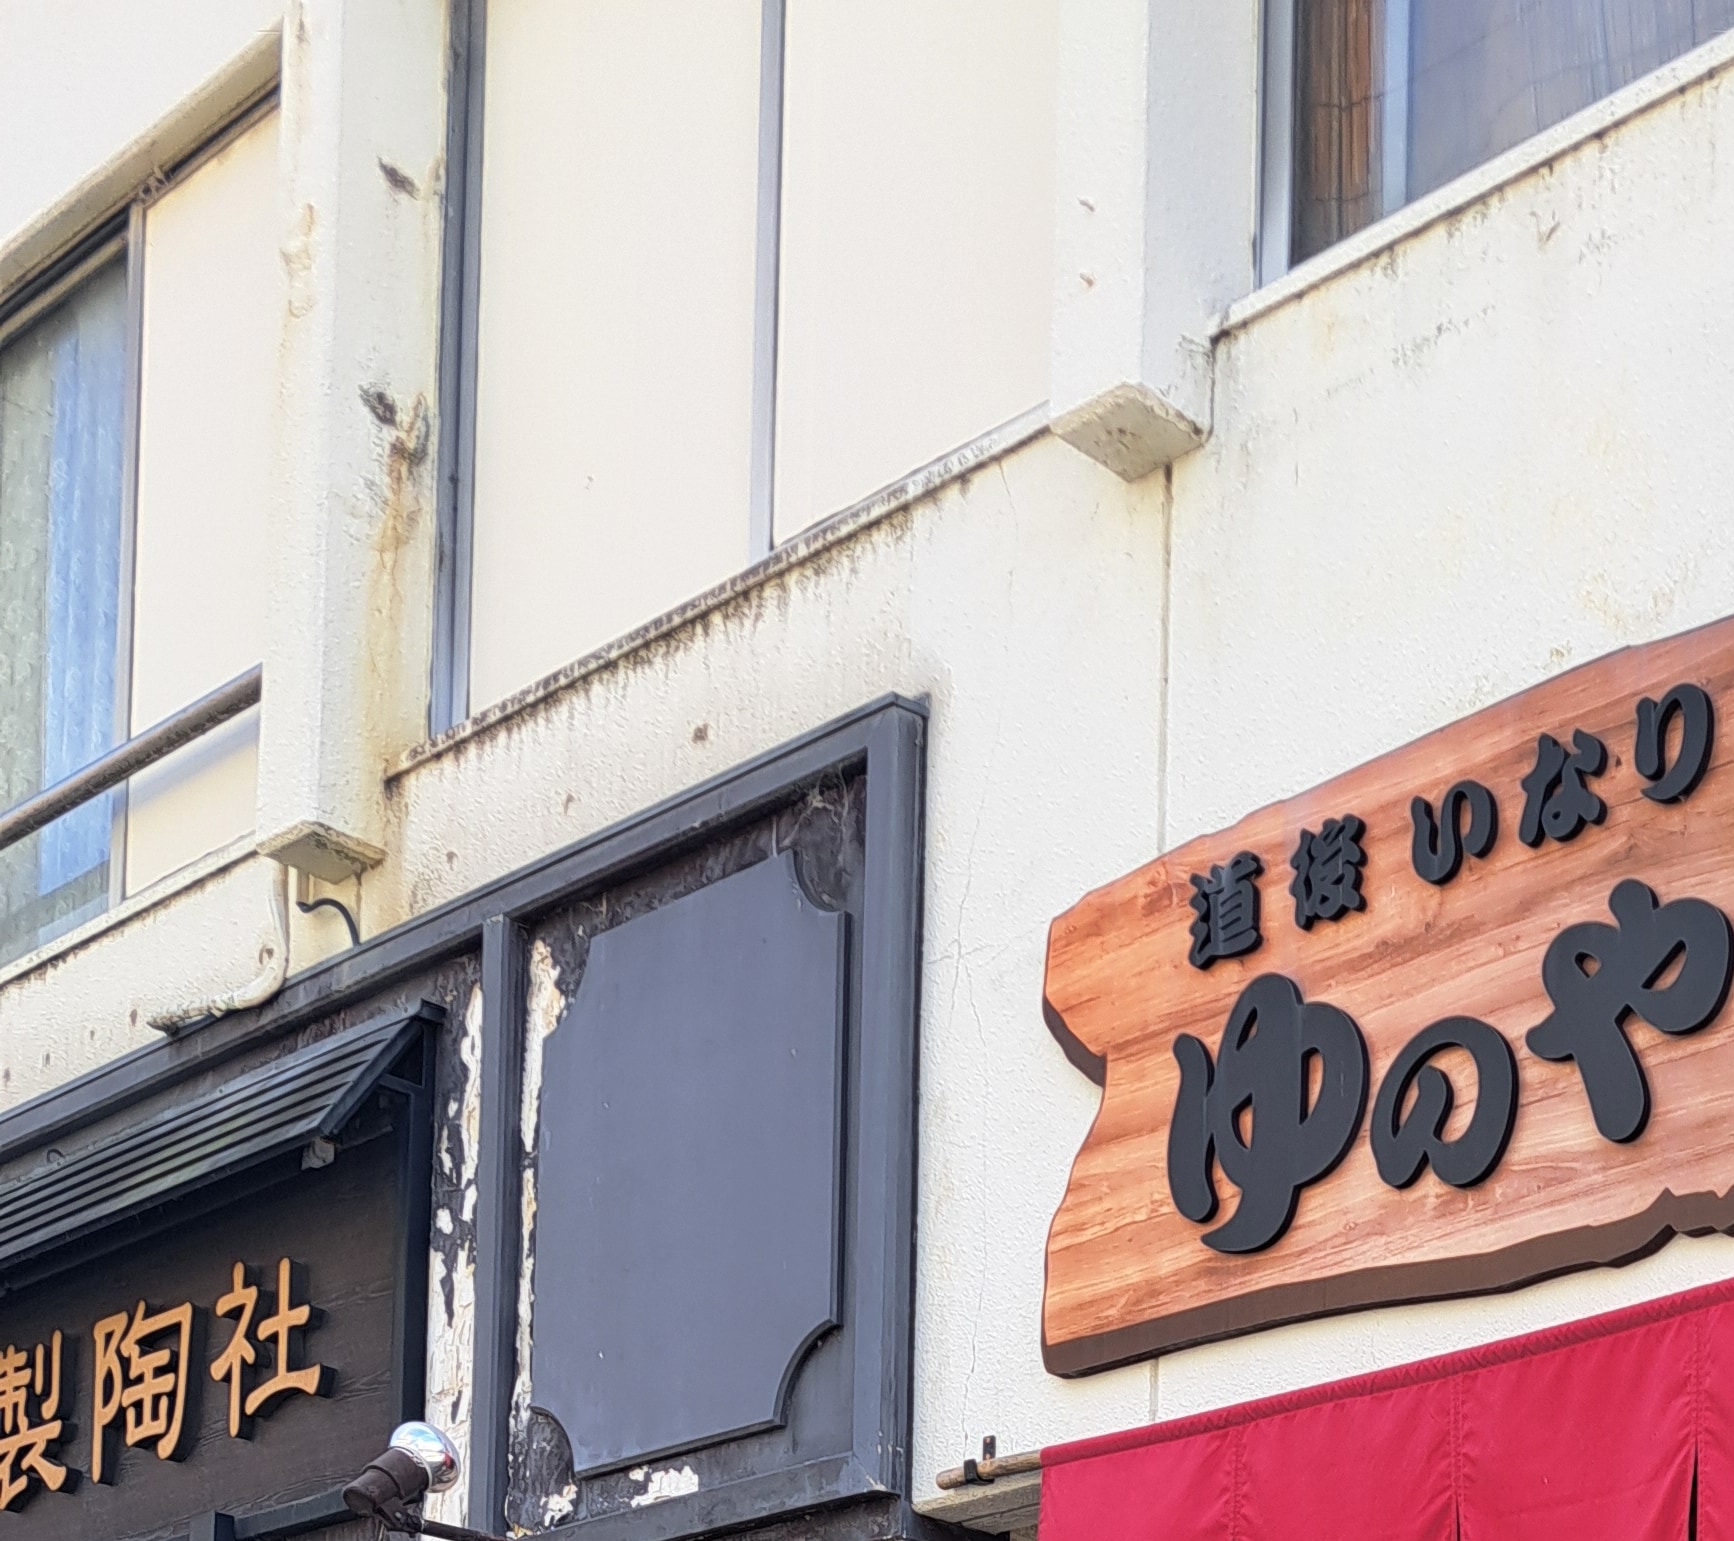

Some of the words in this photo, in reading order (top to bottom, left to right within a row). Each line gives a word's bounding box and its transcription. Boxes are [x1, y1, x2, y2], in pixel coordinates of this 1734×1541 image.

[1189, 683, 1715, 970] 道後いなり
